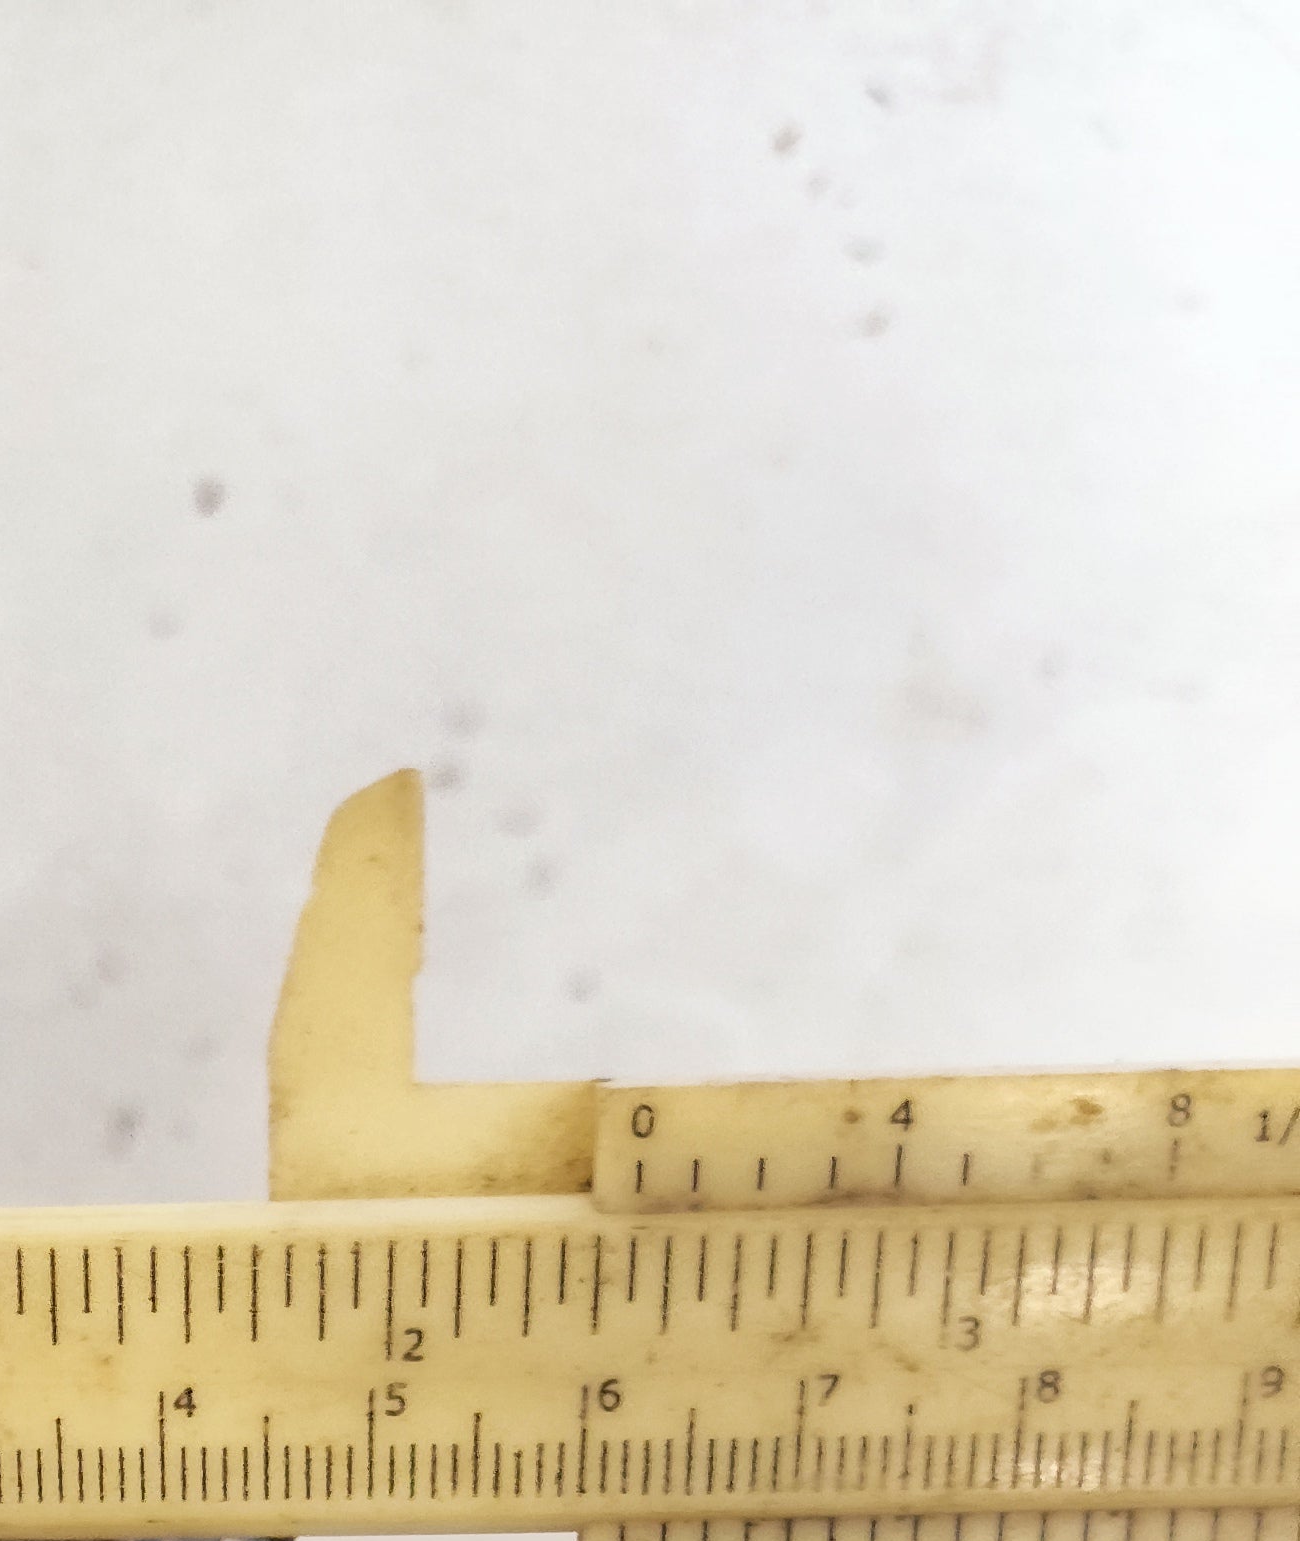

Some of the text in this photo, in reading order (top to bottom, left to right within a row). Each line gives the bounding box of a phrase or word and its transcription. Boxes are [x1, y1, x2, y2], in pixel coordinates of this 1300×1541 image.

[630, 1103, 655, 1139] 0
[889, 1098, 915, 1132] 4
[1166, 1092, 1192, 1128] 8
[402, 1327, 424, 1362] 2
[960, 1315, 982, 1352] 3
[173, 1386, 197, 1418] 4
[385, 1382, 407, 1417] 5
[597, 1378, 622, 1413] 6
[819, 1373, 841, 1400] 7
[1036, 1369, 1061, 1403] 8
[1261, 1364, 1287, 1398] 9
